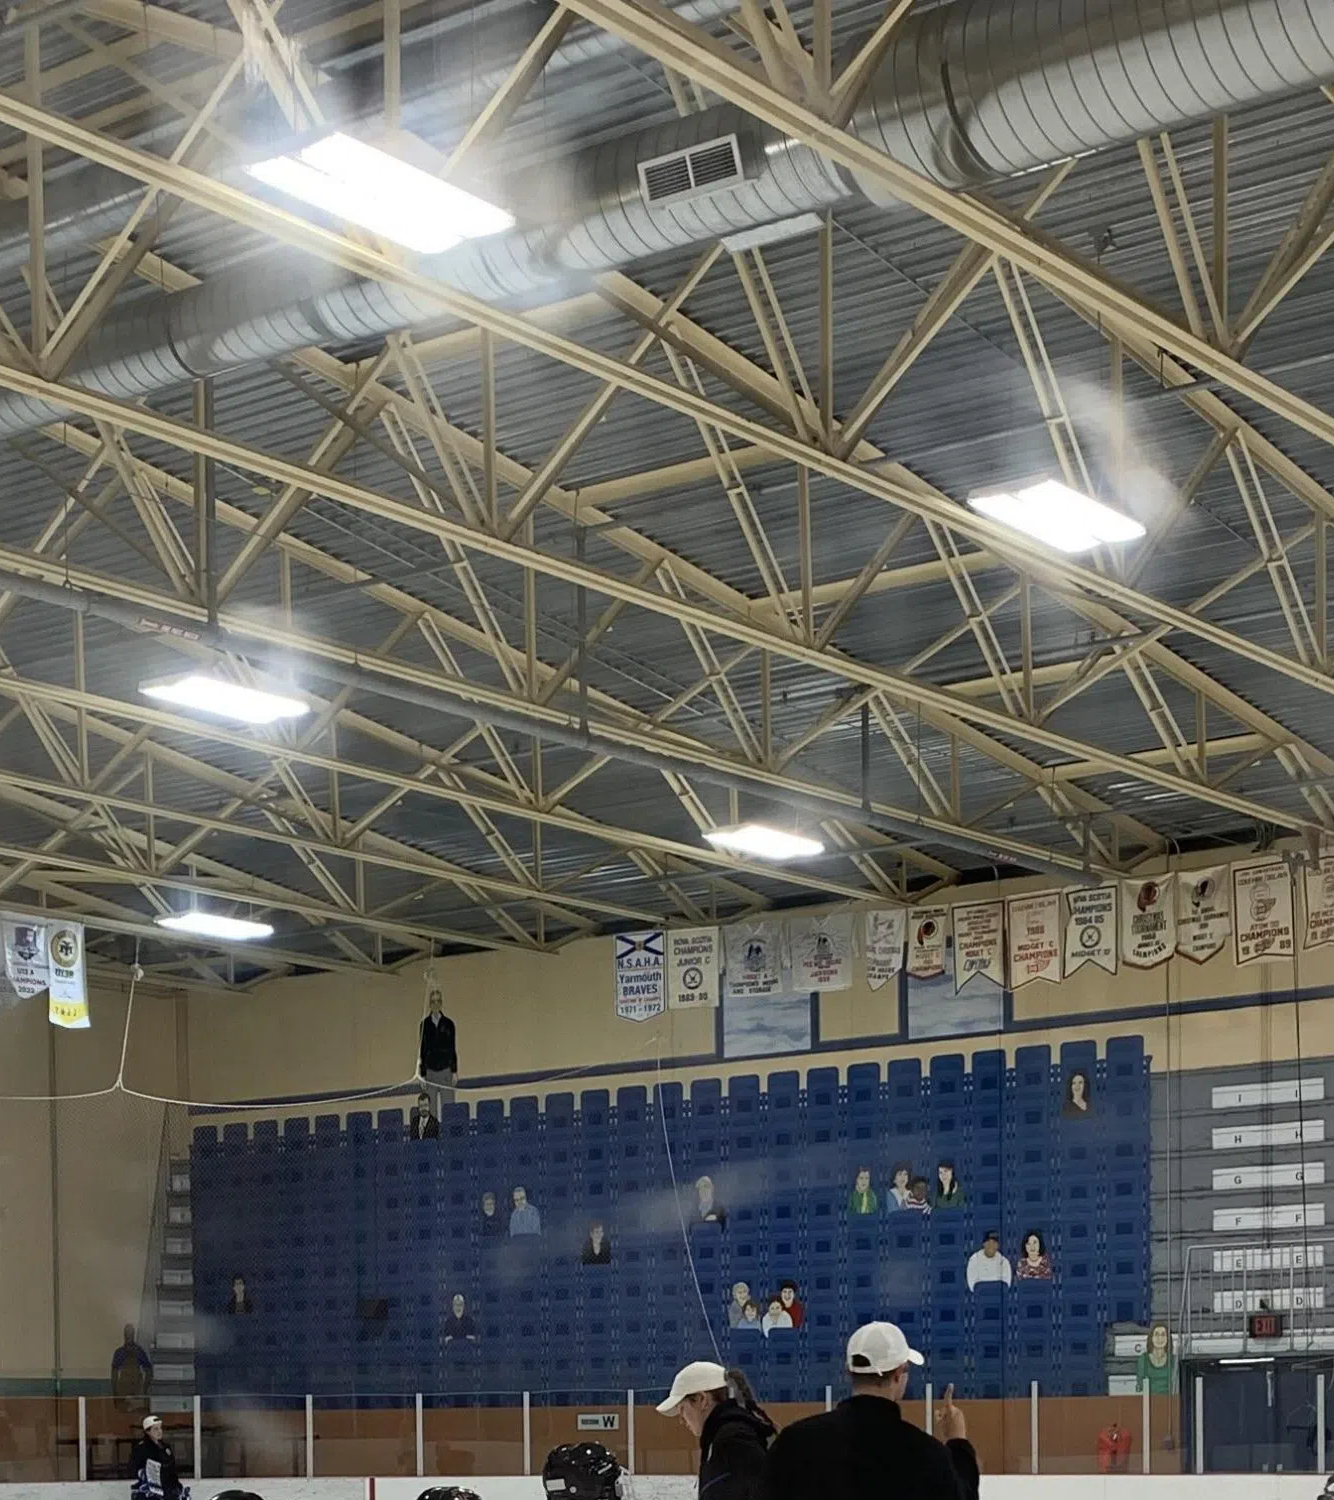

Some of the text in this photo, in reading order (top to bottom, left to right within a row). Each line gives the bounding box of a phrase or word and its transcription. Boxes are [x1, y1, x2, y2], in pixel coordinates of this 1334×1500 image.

[1240, 926, 1289, 942] CHAMPIONS
[619, 972, 661, 984] Yarmouth
[623, 984, 658, 997] BRAVES
[1255, 1318, 1275, 1334] EXIT
[602, 1416, 615, 1428] W
